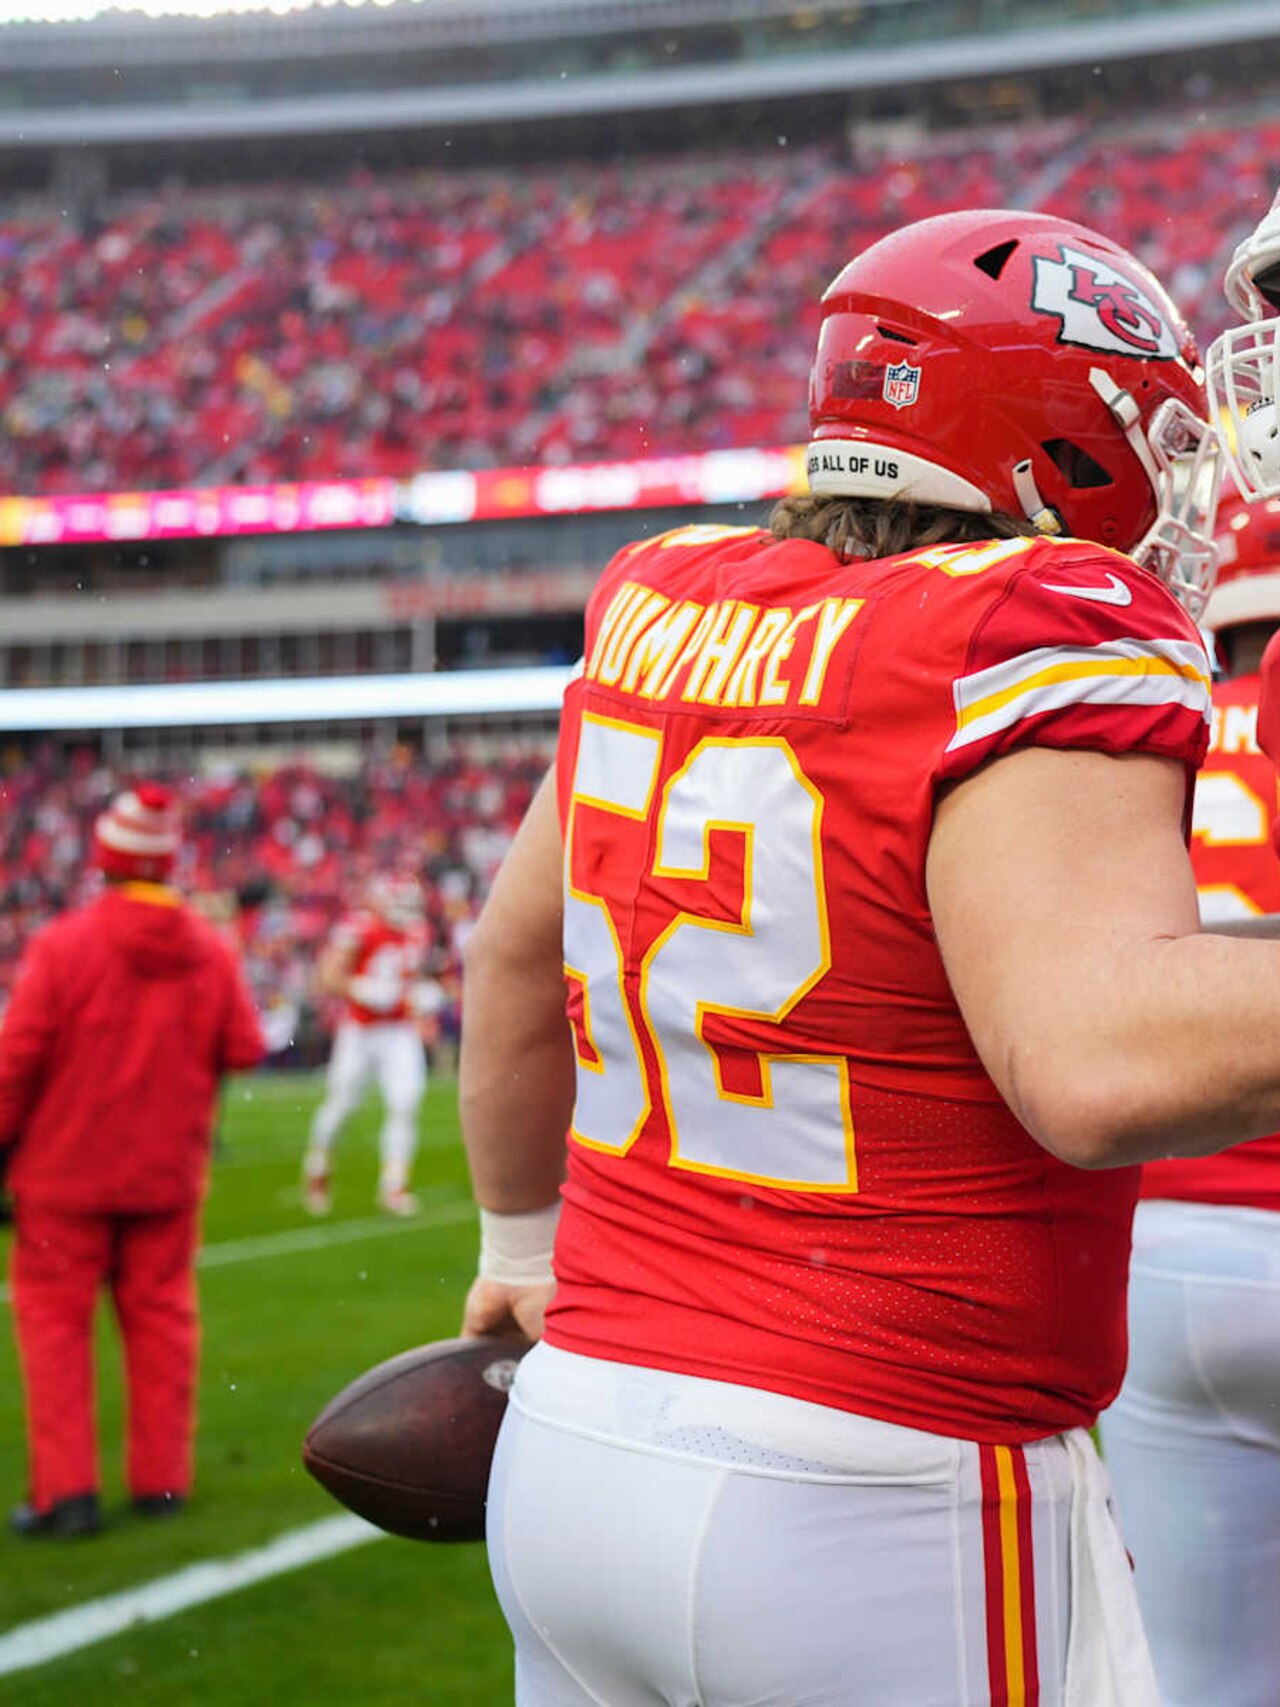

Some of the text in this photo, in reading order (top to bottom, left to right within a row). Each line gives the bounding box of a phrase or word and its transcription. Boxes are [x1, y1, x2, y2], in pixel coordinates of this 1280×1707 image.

[1067, 264, 1162, 353] KC
[888, 380, 914, 400] NFL
[823, 455, 845, 472] ALL
[848, 456, 869, 473] OF
[874, 459, 899, 479] US
[586, 581, 865, 707] HUMPHREY
[563, 711, 858, 1194] 52
